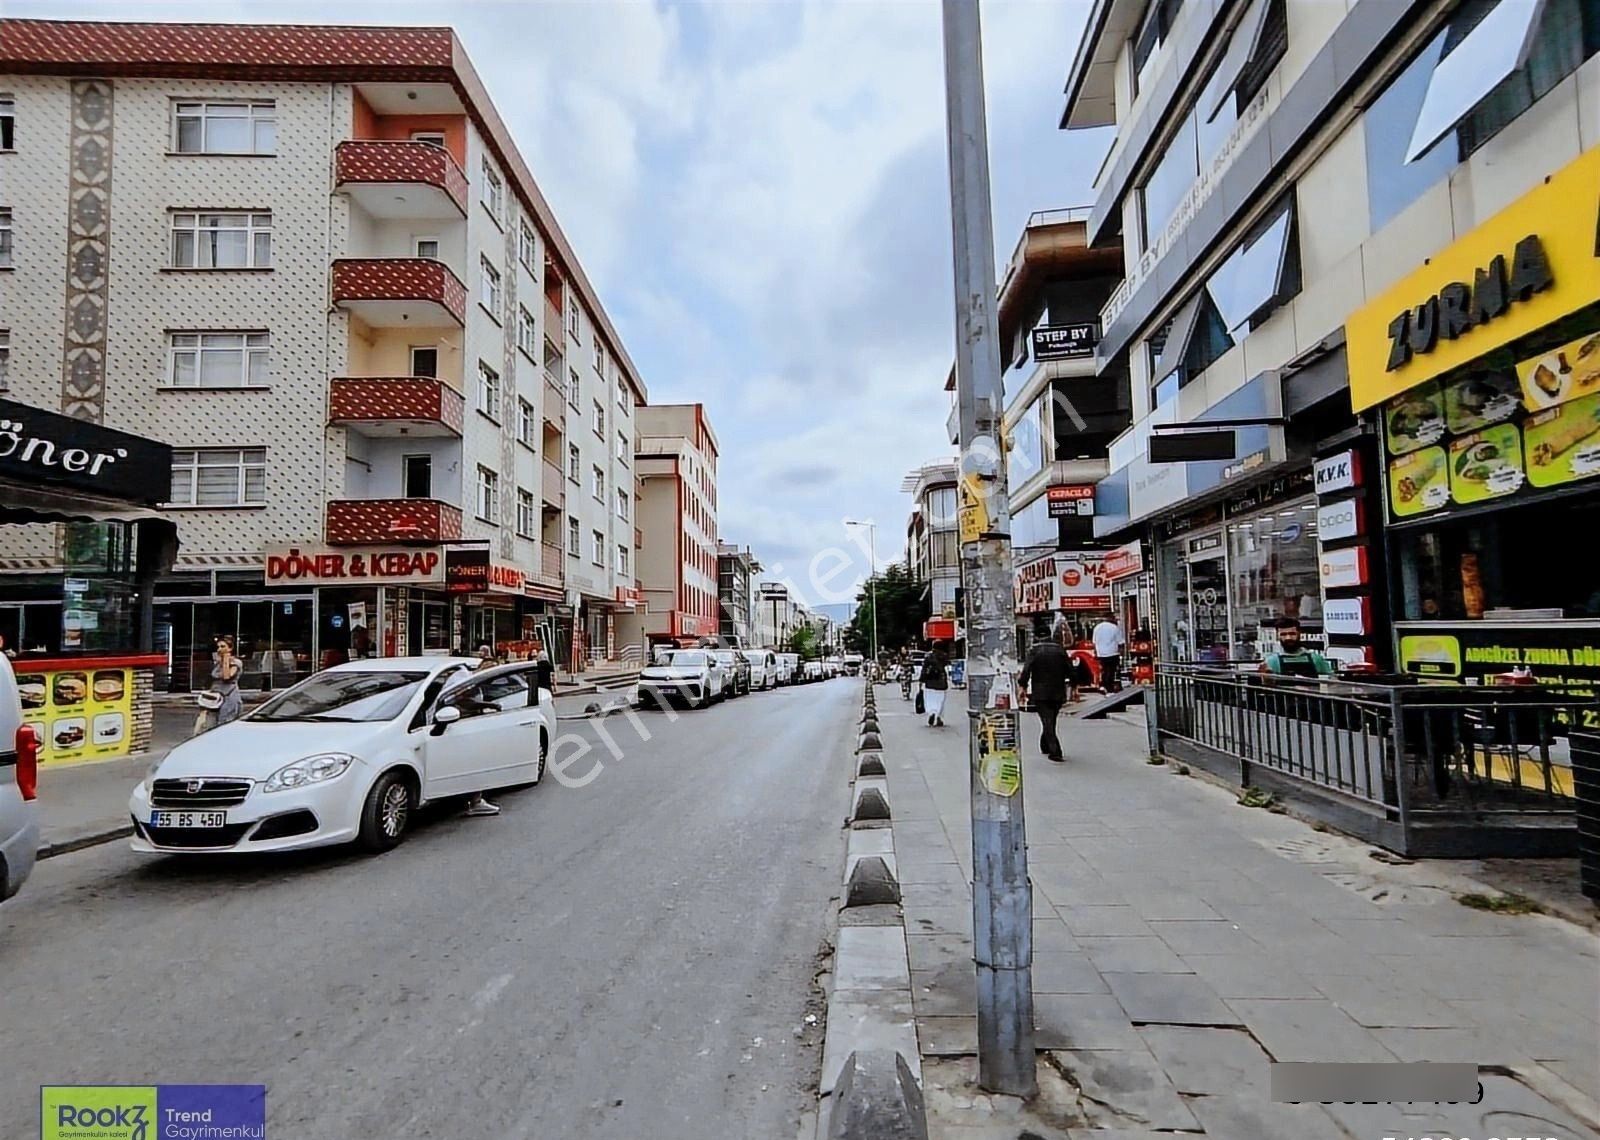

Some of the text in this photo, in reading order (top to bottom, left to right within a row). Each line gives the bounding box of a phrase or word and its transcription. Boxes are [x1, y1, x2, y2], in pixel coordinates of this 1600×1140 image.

[1386, 233, 1555, 373] ZURNA
[1036, 327, 1088, 343] STEP BY
[1316, 462, 1350, 485] K.V.K.
[267, 548, 438, 579] DÖNER & KEBAP
[159, 813, 171, 827] 55
[200, 813, 223, 827] 450
